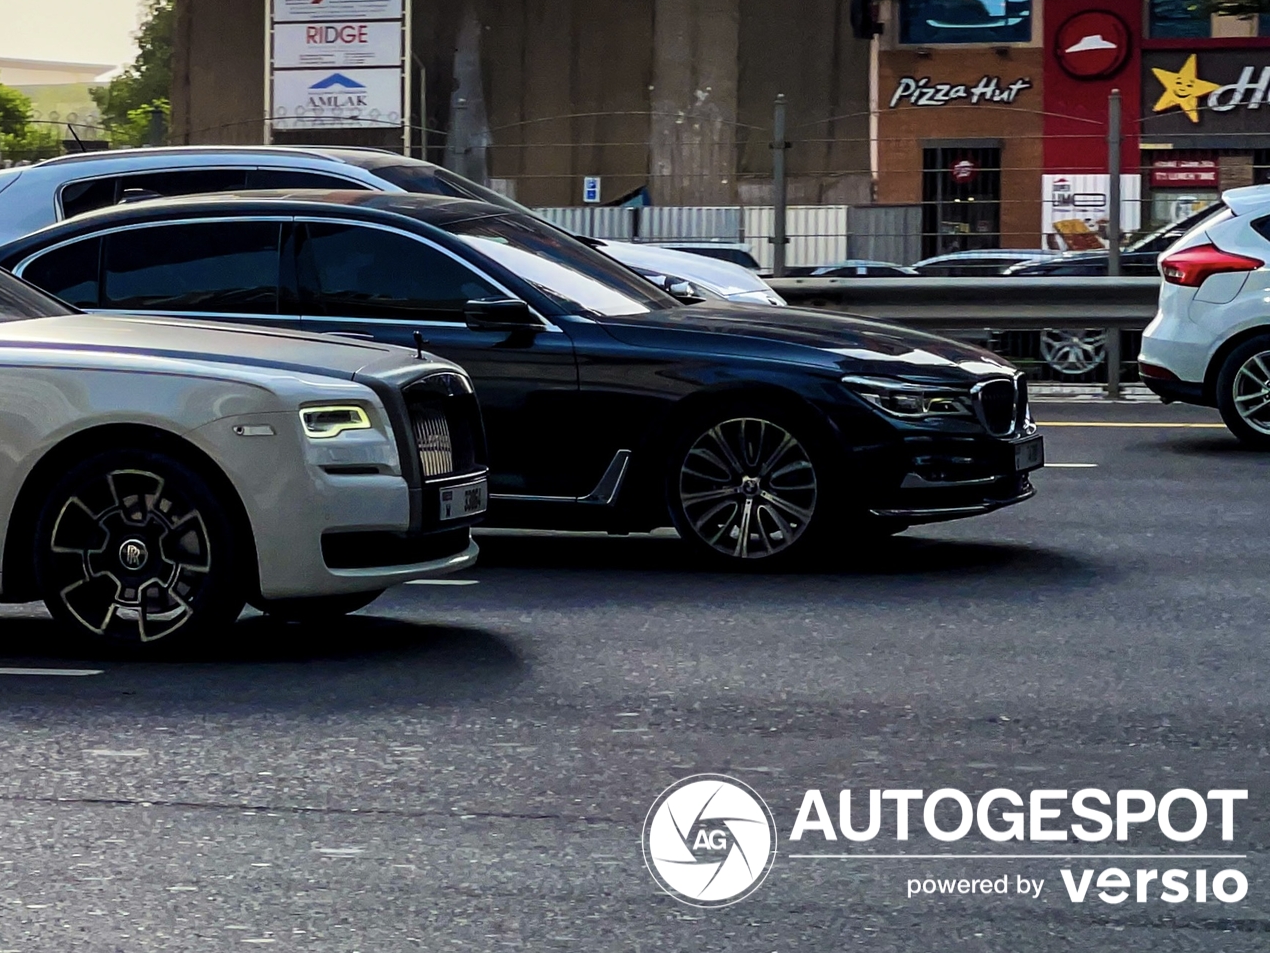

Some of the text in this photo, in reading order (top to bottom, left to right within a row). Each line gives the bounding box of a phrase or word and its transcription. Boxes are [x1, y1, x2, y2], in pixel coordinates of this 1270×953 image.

[306, 25, 368, 44] RIDGE
[306, 95, 368, 108] AMLAK
[889, 76, 1031, 108] Pizza Hut
